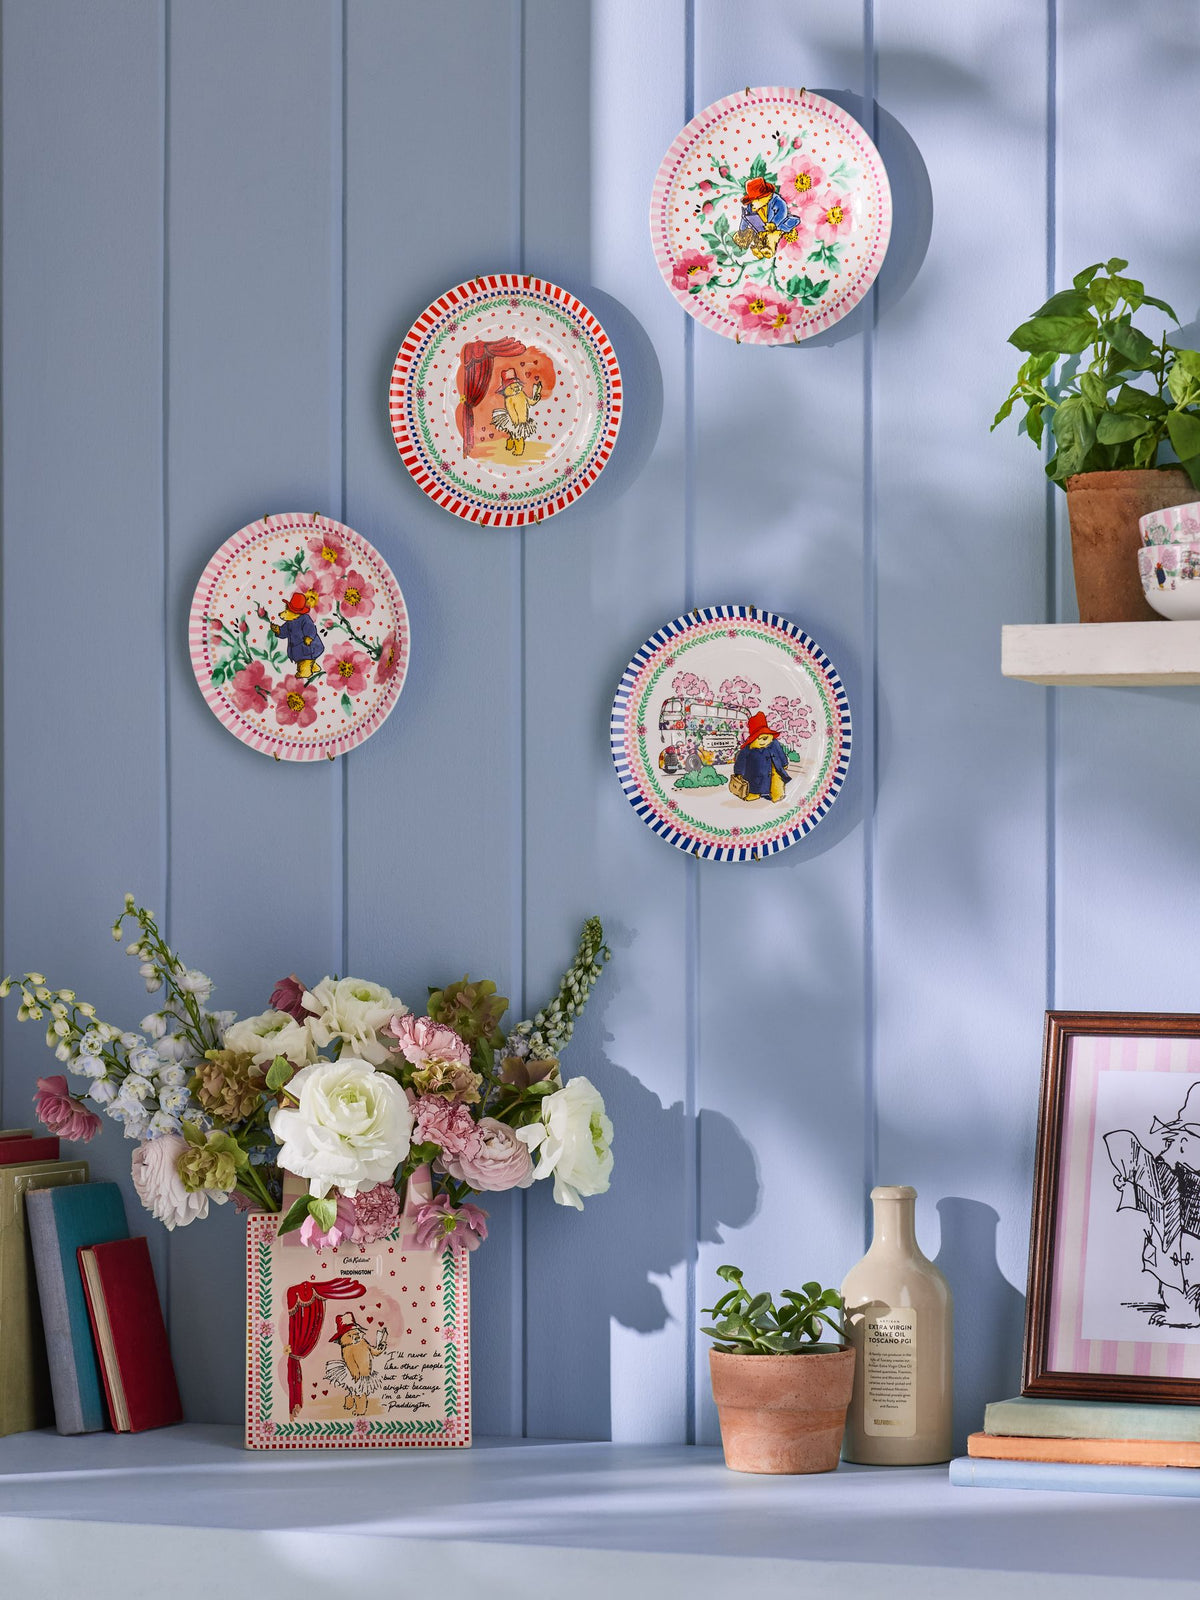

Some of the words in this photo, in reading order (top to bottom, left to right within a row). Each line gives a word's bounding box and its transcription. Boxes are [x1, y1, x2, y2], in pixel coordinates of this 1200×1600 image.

[421, 1362, 443, 1372] people
[383, 1384, 409, 1394] alright
[412, 1382, 440, 1392] because
